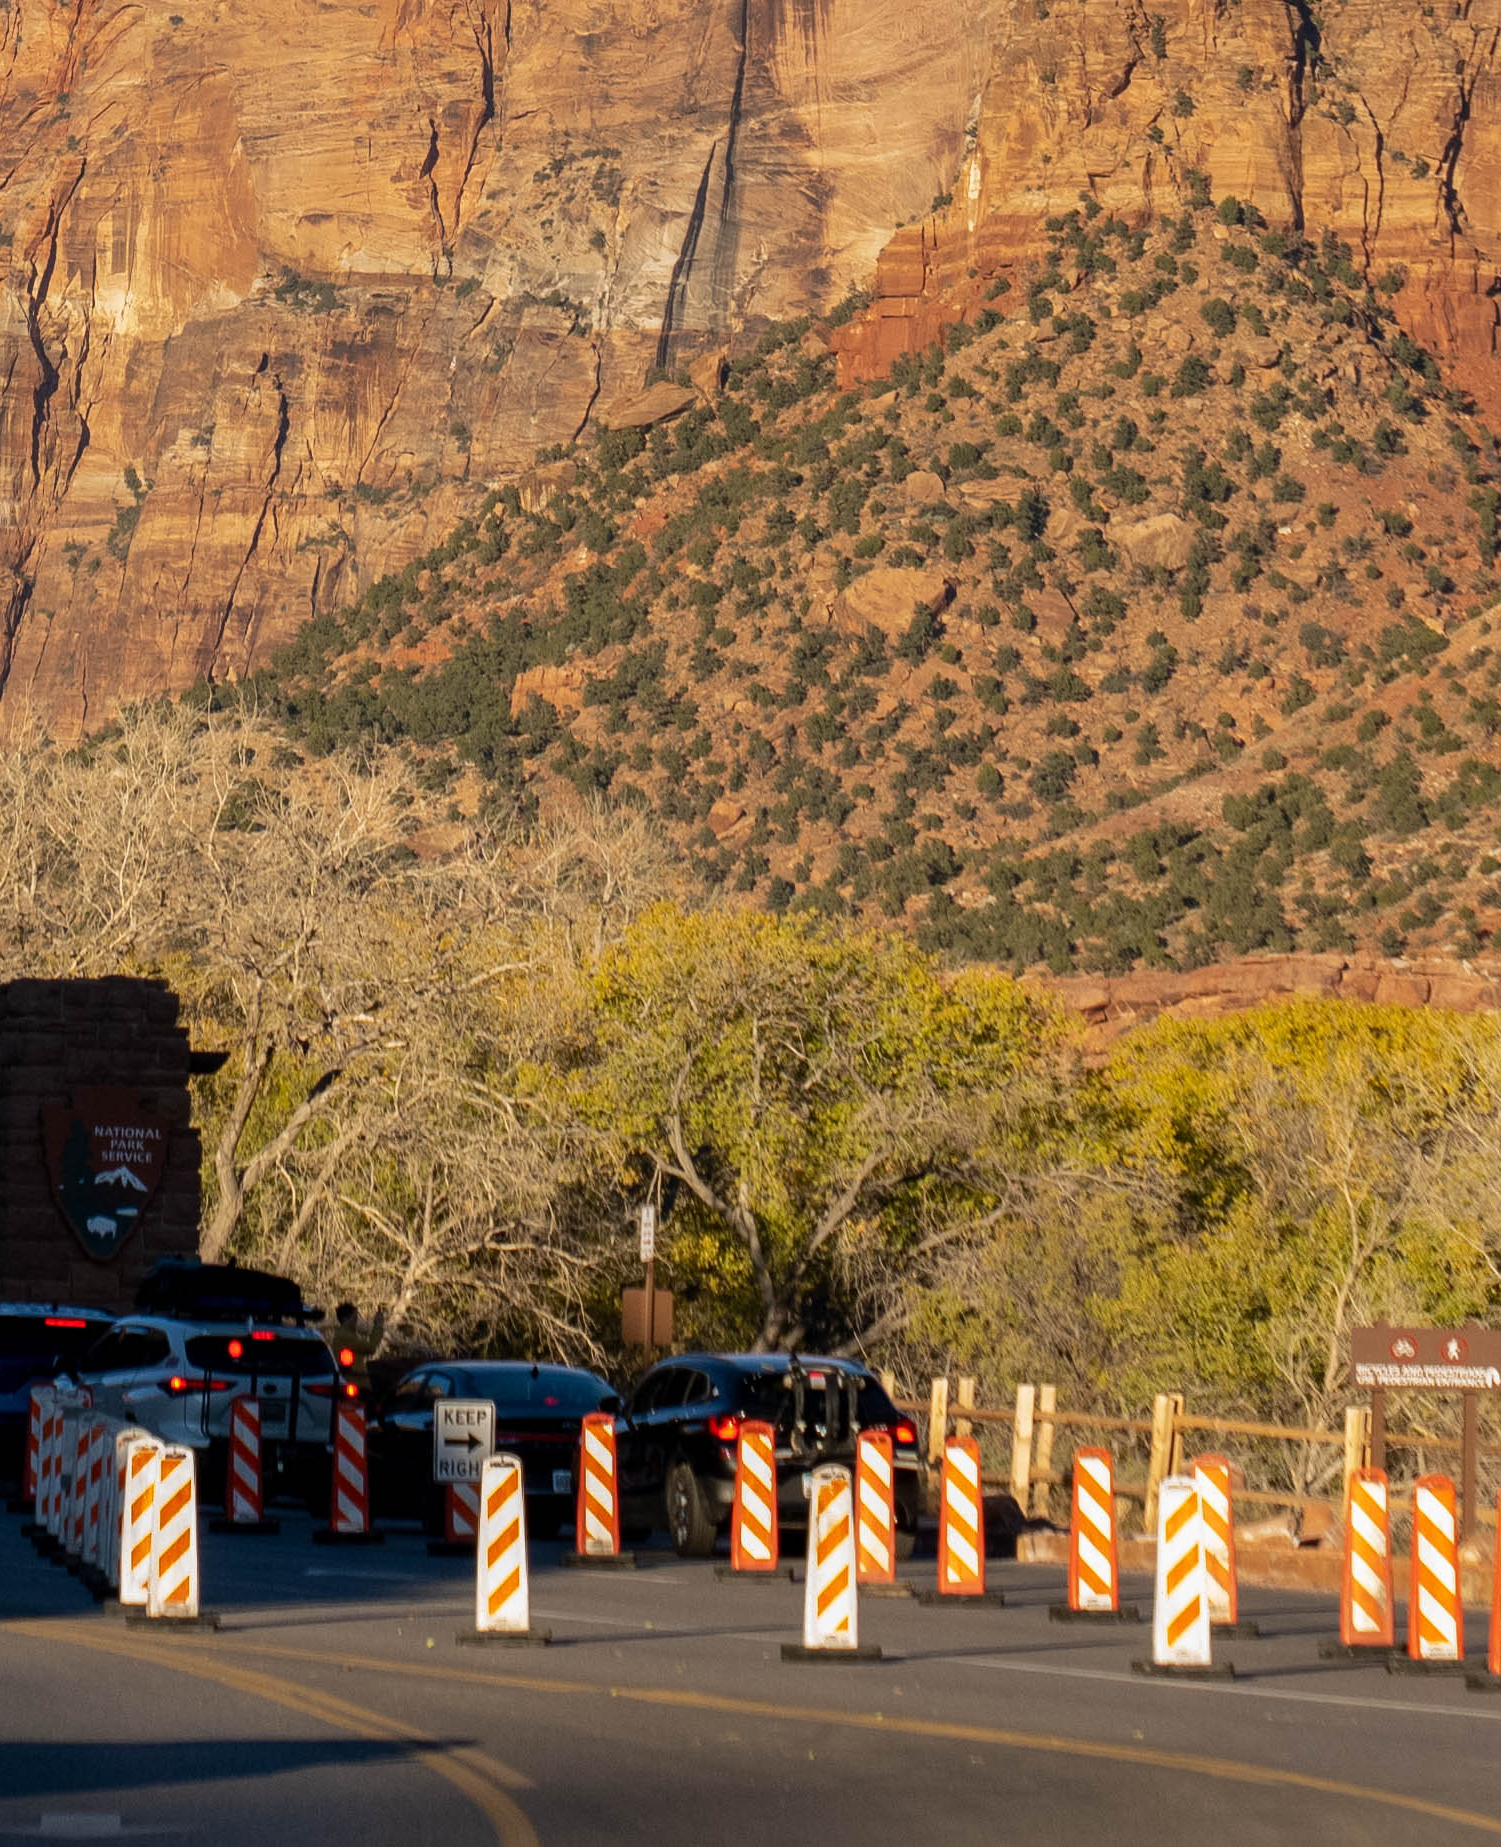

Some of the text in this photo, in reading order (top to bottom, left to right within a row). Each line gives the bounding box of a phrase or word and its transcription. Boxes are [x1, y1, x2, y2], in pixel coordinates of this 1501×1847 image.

[94, 1125, 162, 1141] NATIONAL
[110, 1139, 144, 1150] PARK
[101, 1151, 153, 1164] SERVICE
[444, 1408, 487, 1425] KEEP
[440, 1459, 480, 1477] RIGH
